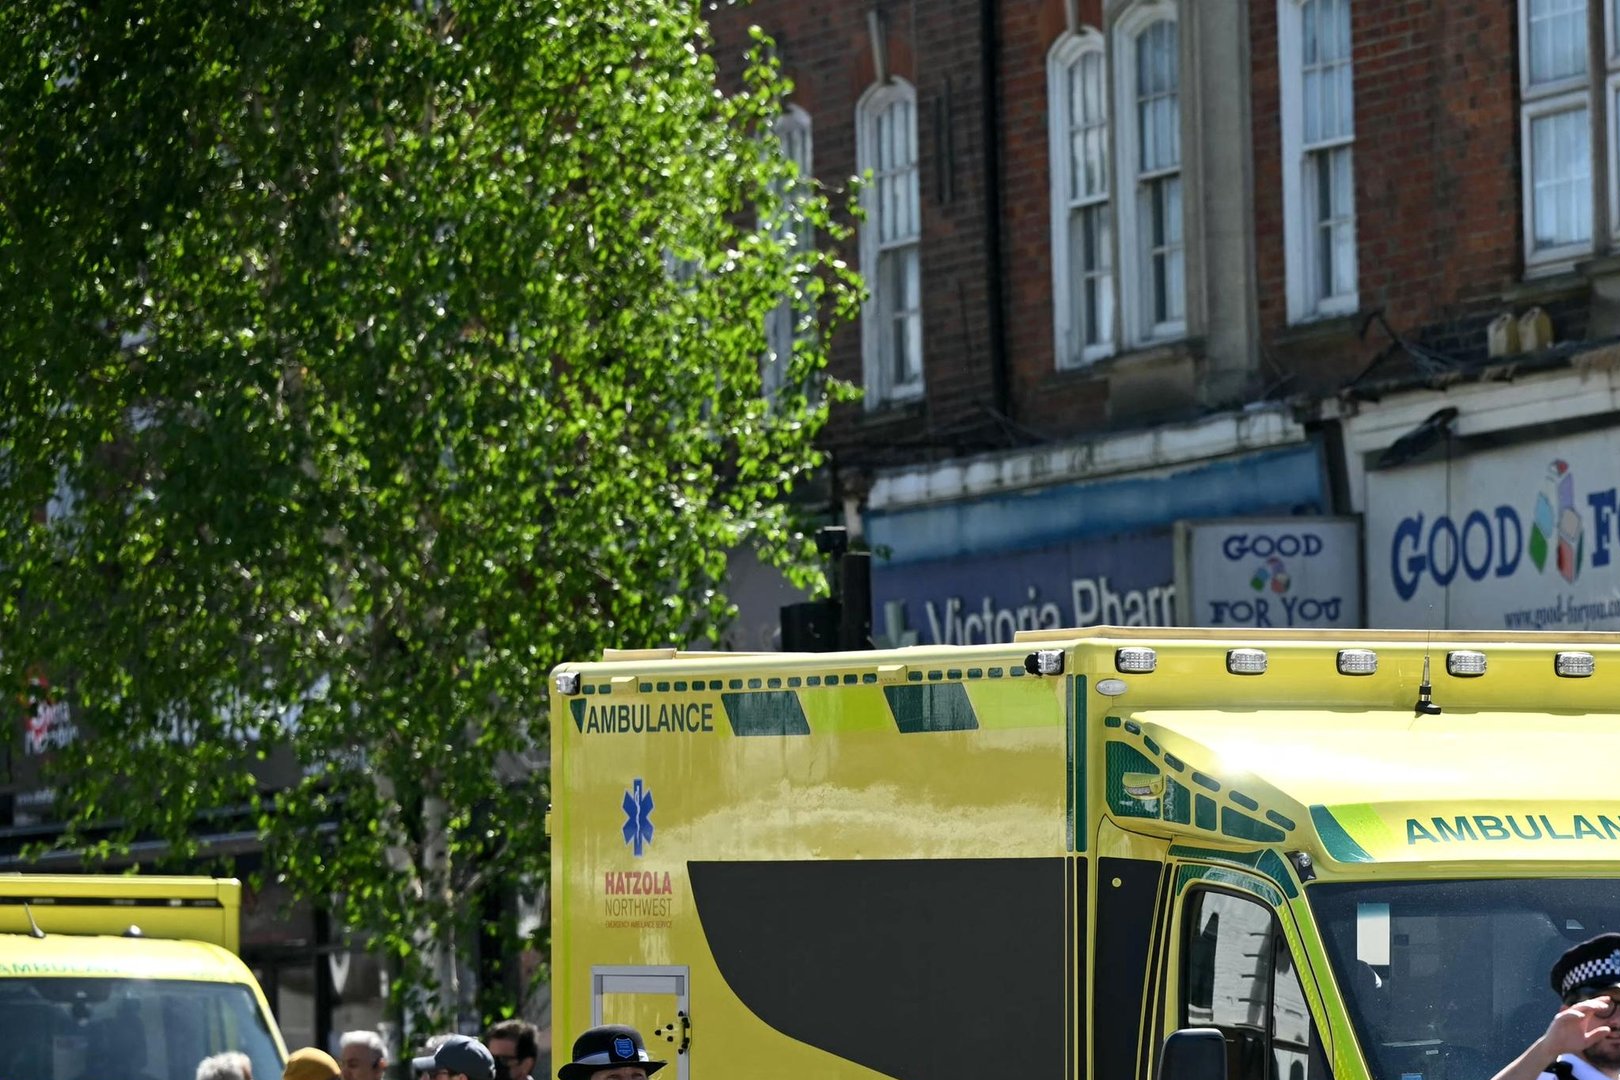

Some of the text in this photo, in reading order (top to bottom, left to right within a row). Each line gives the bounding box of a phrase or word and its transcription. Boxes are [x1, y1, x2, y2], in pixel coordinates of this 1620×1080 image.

[1223, 533, 1323, 561] GOOD
[1391, 505, 1523, 600] GOOD
[926, 586, 1061, 646] Victoria
[1210, 596, 1342, 628] FOR YOU
[587, 703, 713, 734] AMBULANCE
[605, 871, 672, 895] HATZOLA
[605, 898, 672, 917] NORTHWEST
